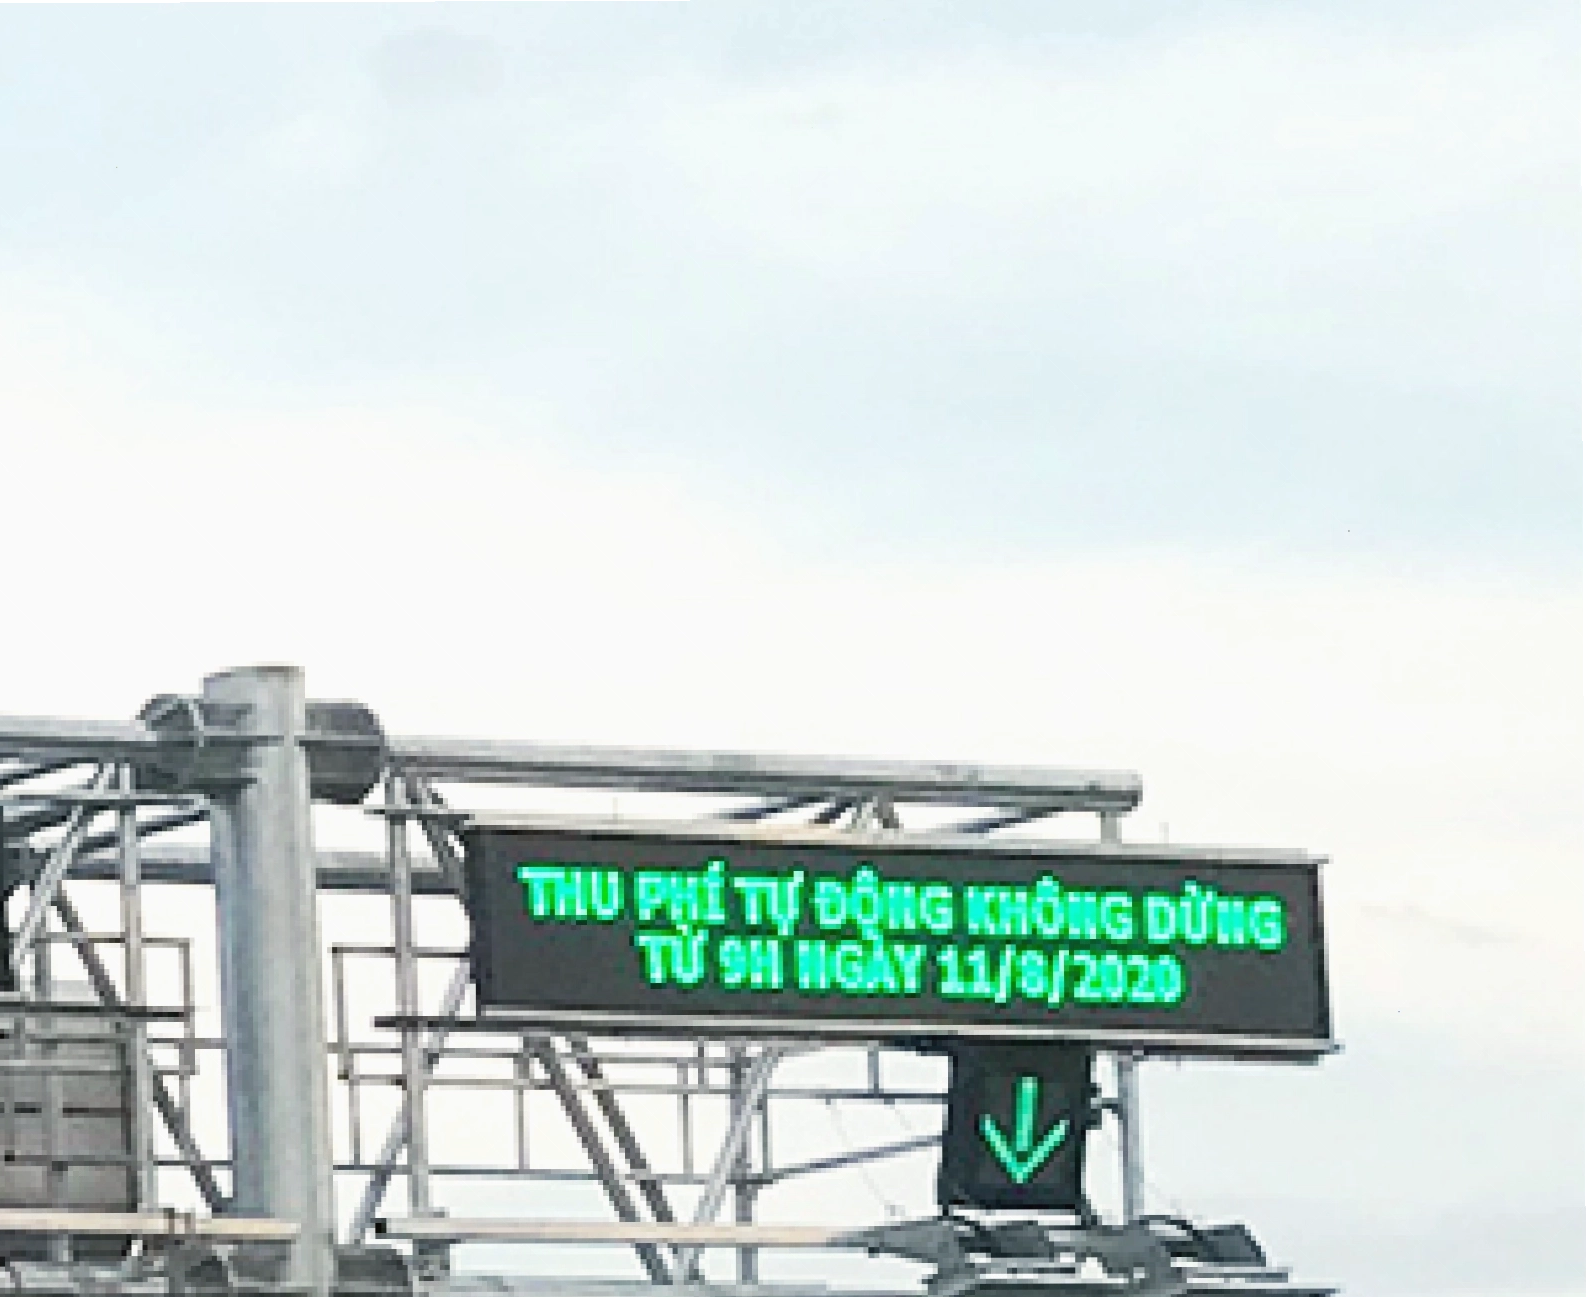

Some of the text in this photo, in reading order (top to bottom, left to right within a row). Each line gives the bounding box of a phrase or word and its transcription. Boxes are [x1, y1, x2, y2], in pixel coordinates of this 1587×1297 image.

[518, 859, 1288, 952] THU PHÍ TỰ ĐỘNG KHÔNG DỪNG
